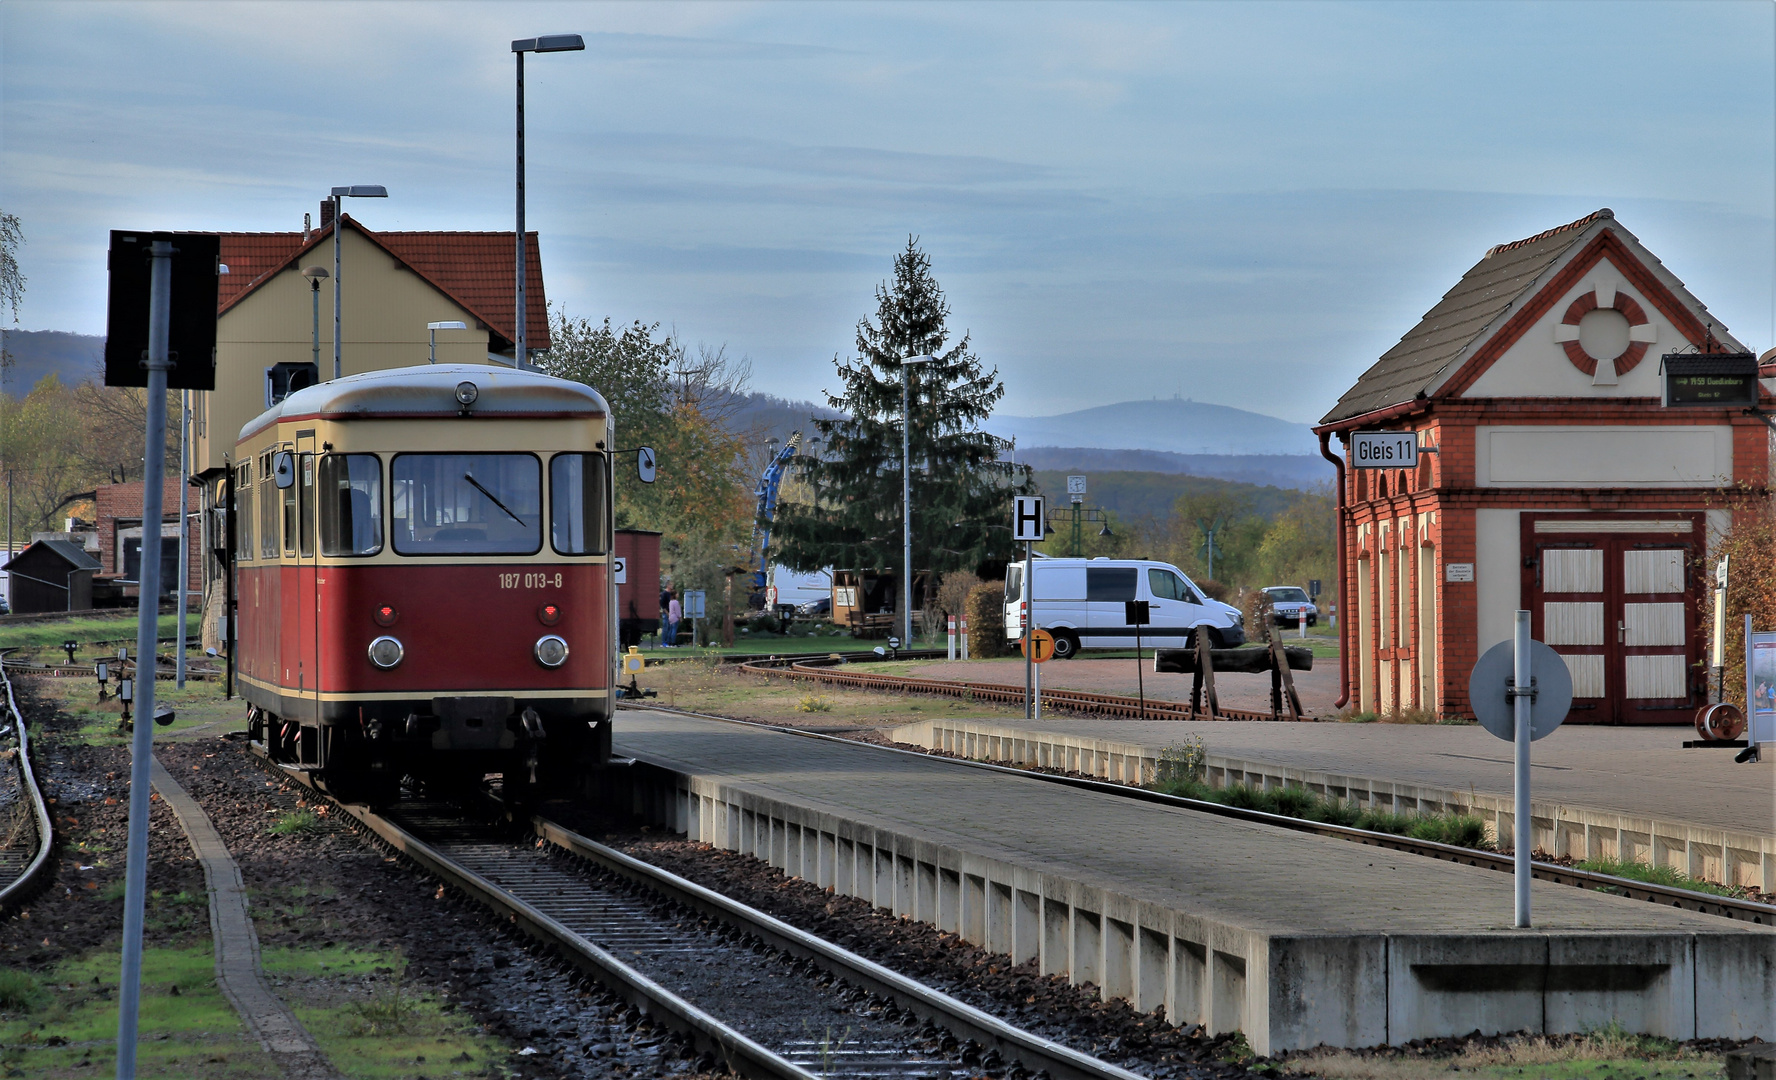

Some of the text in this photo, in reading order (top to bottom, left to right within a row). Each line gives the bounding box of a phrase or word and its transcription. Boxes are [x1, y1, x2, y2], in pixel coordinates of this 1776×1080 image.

[1359, 440, 1411, 460] Gleis 11
[1017, 499, 1041, 537] H
[498, 572, 563, 589] 187 013-8
